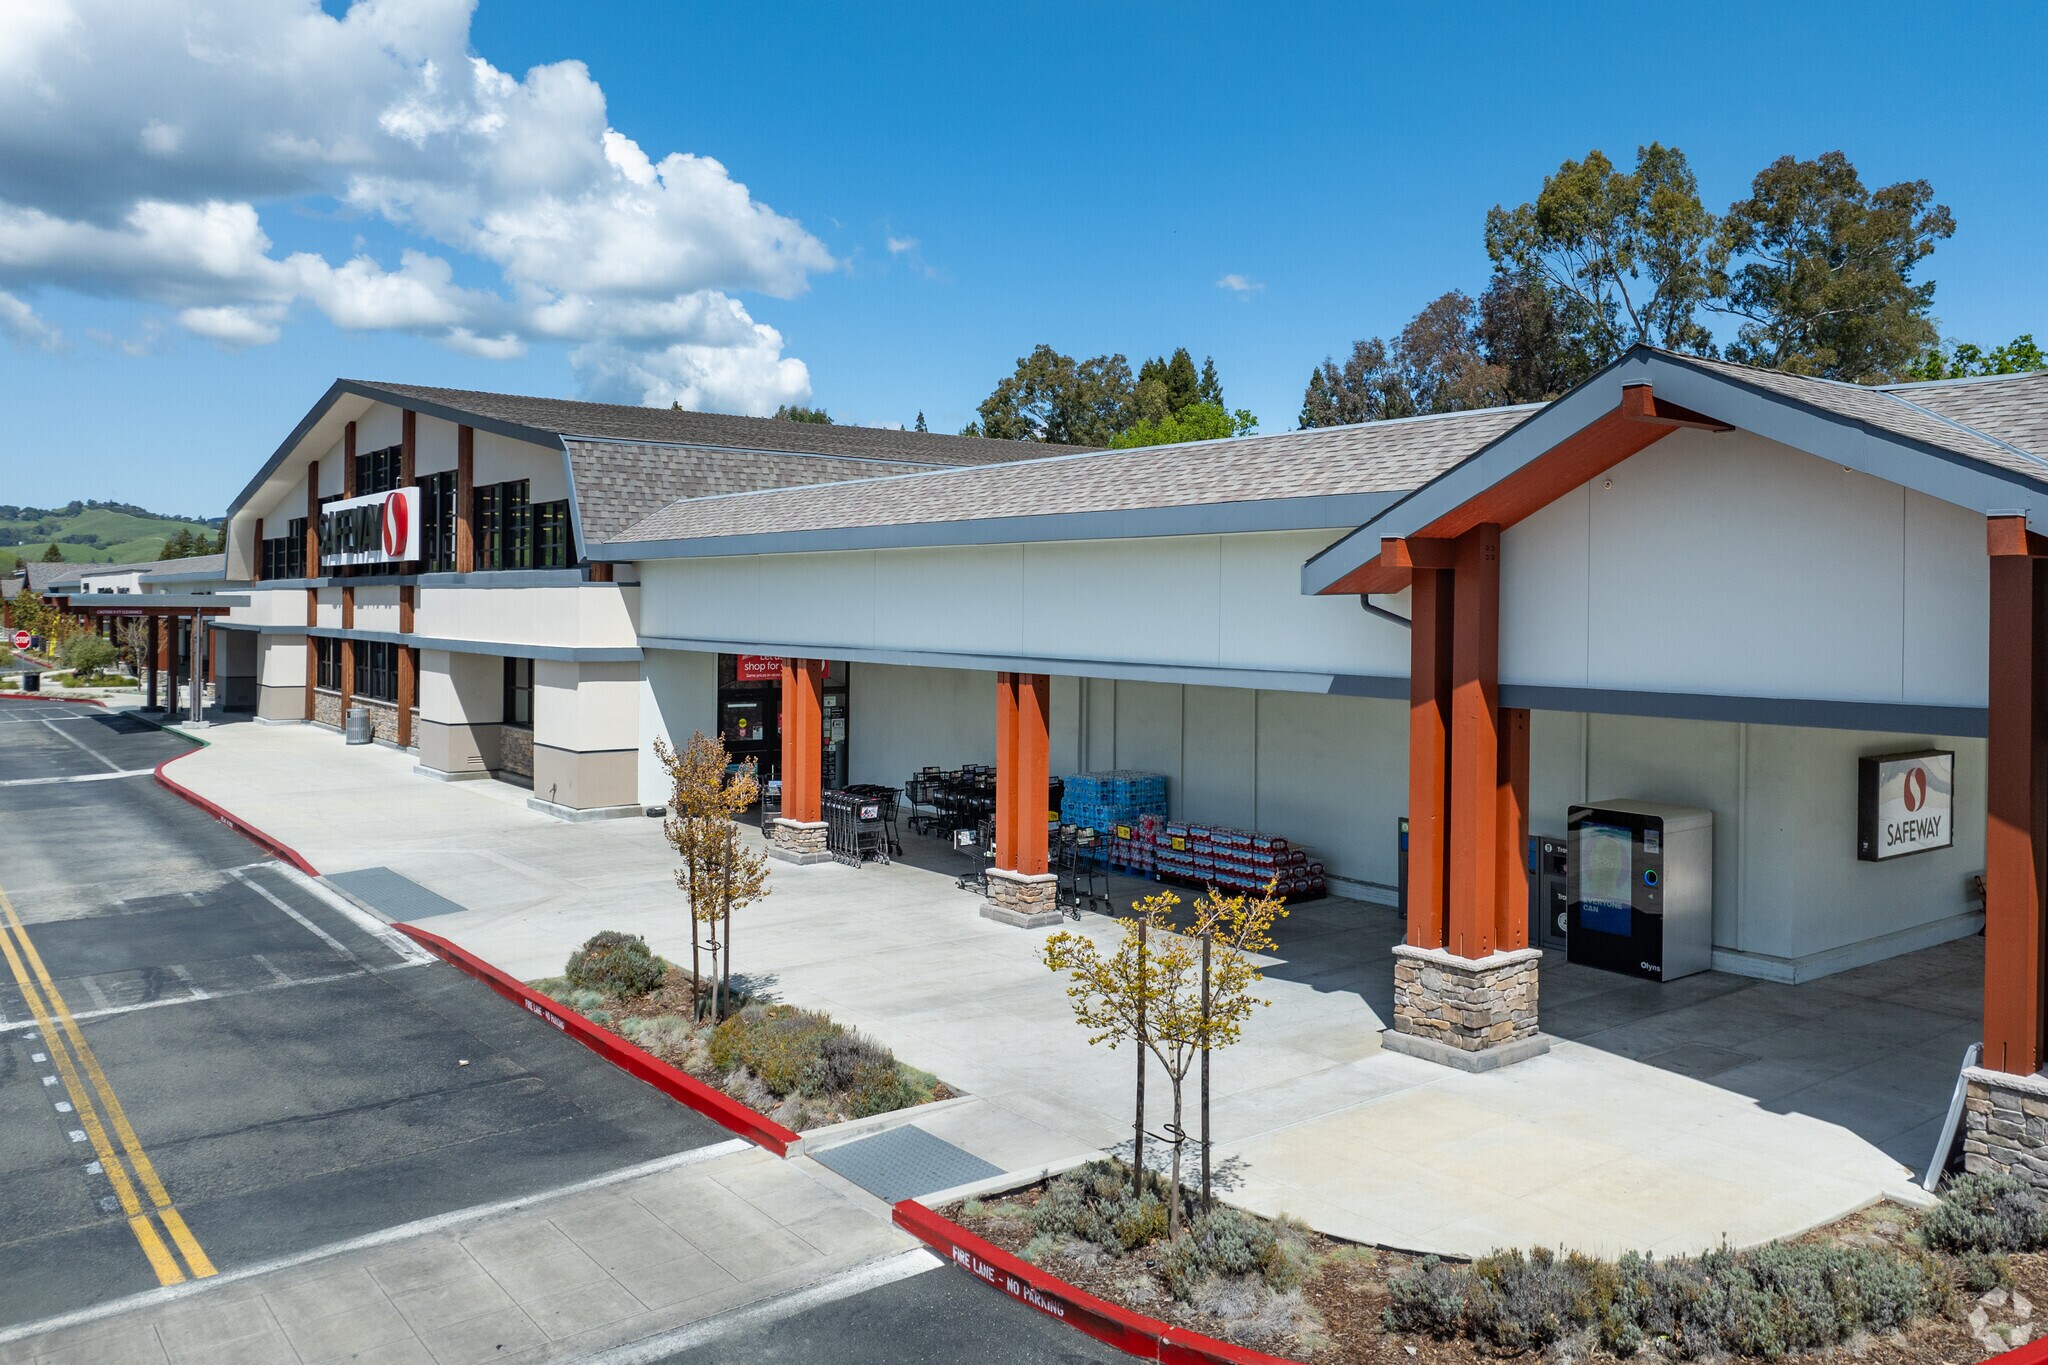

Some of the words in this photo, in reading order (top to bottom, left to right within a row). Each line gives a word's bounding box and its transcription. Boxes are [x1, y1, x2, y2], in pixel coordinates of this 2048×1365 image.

[744, 662, 766, 672] shop
[767, 662, 779, 670] for
[1887, 815, 1942, 847] SAFEWAY
[1583, 896, 1623, 910] EVERYONE
[1583, 904, 1599, 913] CAN
[1640, 961, 1661, 973] Olyns
[952, 1245, 971, 1269] FIRE
[973, 1257, 995, 1283] LANE
[1006, 1276, 1020, 1296] NO
[1023, 1285, 1065, 1317] PARKING
